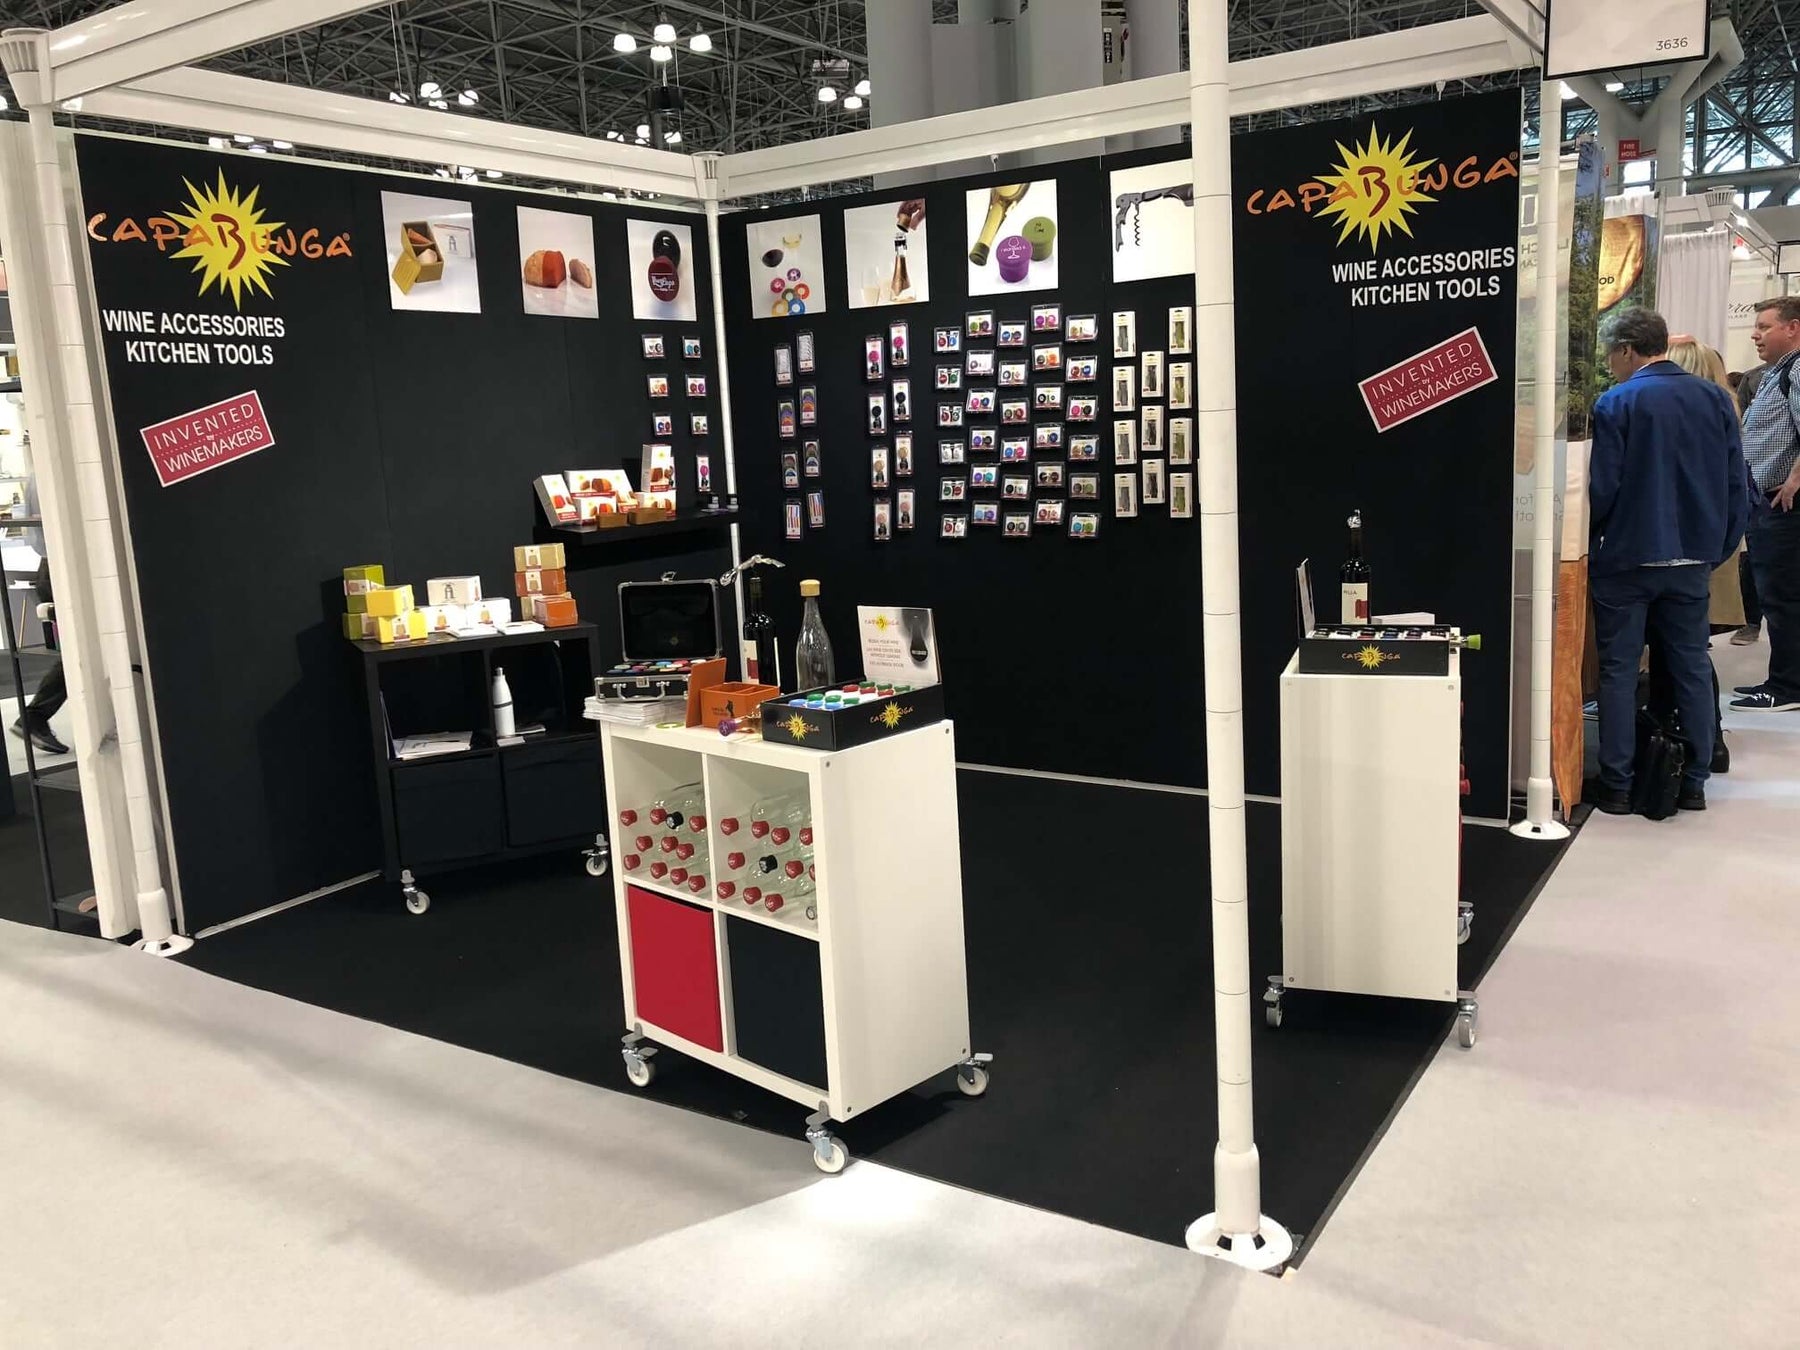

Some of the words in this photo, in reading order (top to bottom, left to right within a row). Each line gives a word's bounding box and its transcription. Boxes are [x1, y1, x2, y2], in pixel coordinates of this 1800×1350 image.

[1656, 37, 1689, 51] 3636
[1332, 260, 1377, 283] WINE
[1381, 246, 1515, 278] ACCESSORIES
[1351, 282, 1430, 307] KITCHEN
[1435, 275, 1500, 299] TOOLS
[102, 309, 156, 333] WINE
[160, 312, 285, 338] ACCESSORIES
[125, 340, 211, 364] KITCHEN
[213, 343, 274, 365] TOOLS
[1372, 342, 1472, 399] INVENTED
[1380, 362, 1482, 418] WINEMAKERS
[153, 403, 254, 450] INVENTED
[163, 425, 263, 473] WINEMAKERS
